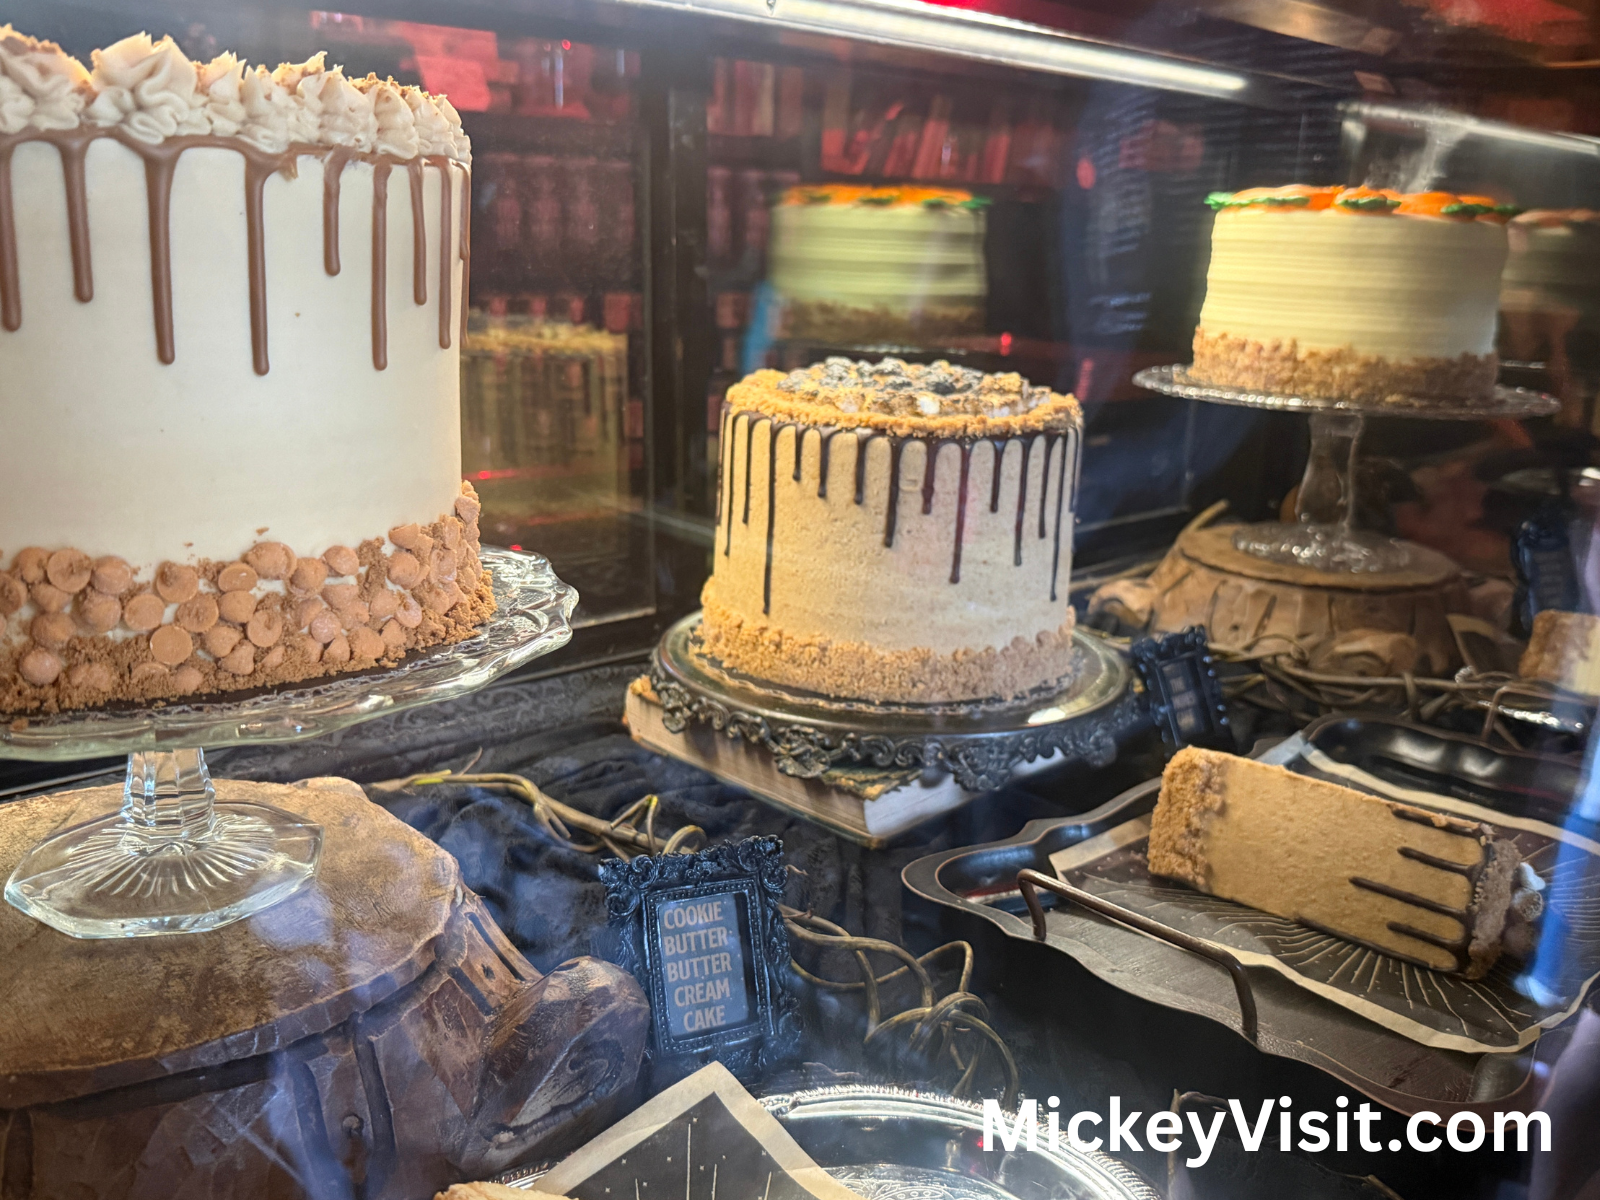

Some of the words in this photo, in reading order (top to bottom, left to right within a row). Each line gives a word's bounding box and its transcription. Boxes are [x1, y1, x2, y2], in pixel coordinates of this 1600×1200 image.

[664, 902, 723, 930] COOKIE
[664, 927, 729, 956] BUTTER
[667, 953, 732, 982] BUTTER
[674, 978, 731, 1007] CREAM
[683, 1005, 726, 1032] CAKE
